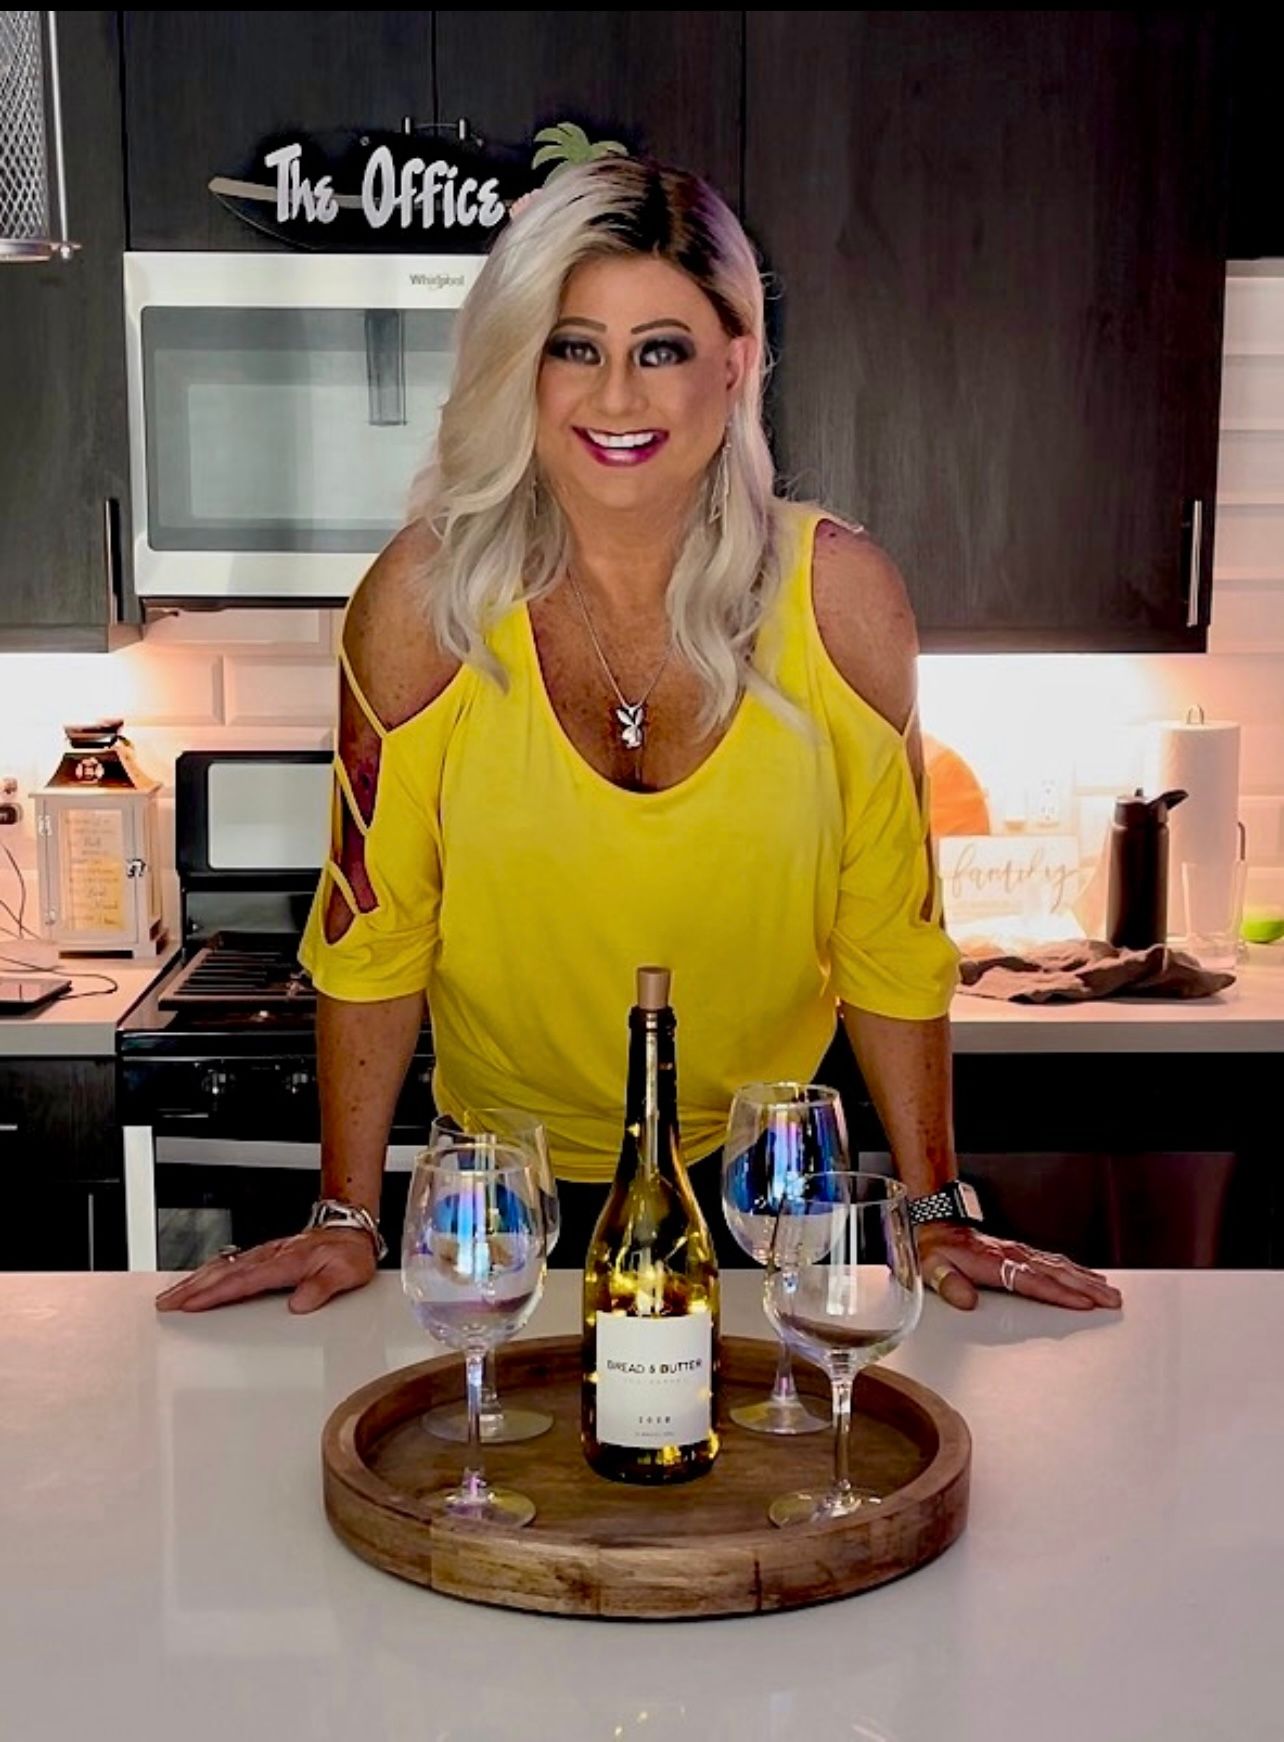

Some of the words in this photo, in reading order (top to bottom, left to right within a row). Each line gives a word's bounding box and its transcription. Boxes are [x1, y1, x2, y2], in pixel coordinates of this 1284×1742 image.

[264, 143, 339, 223] The
[362, 145, 504, 229] Office
[607, 1359, 645, 1374] BREAD
[659, 1358, 703, 1374] BUTTER
